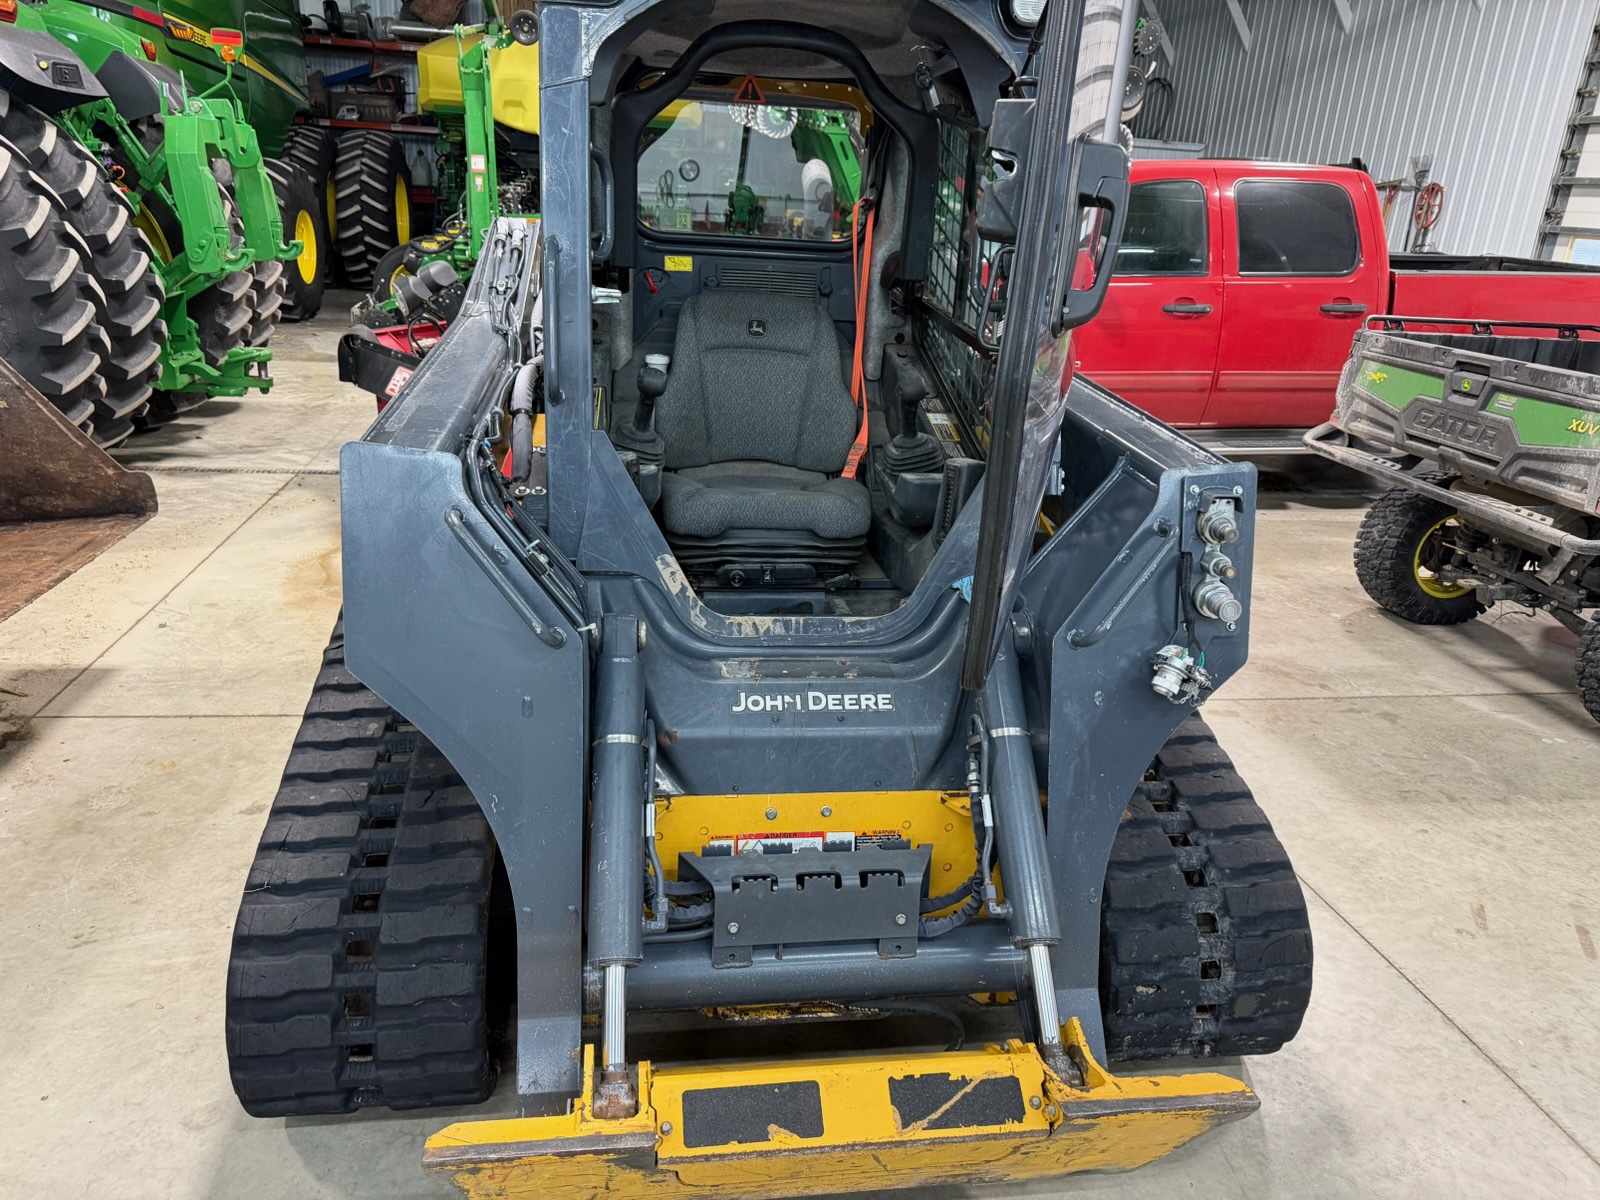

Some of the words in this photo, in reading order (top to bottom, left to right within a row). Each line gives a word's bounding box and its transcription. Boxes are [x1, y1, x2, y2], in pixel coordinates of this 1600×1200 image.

[1413, 407, 1502, 450] GATOR
[1568, 418, 1600, 436] XUV
[807, 691, 893, 711] DEERE
